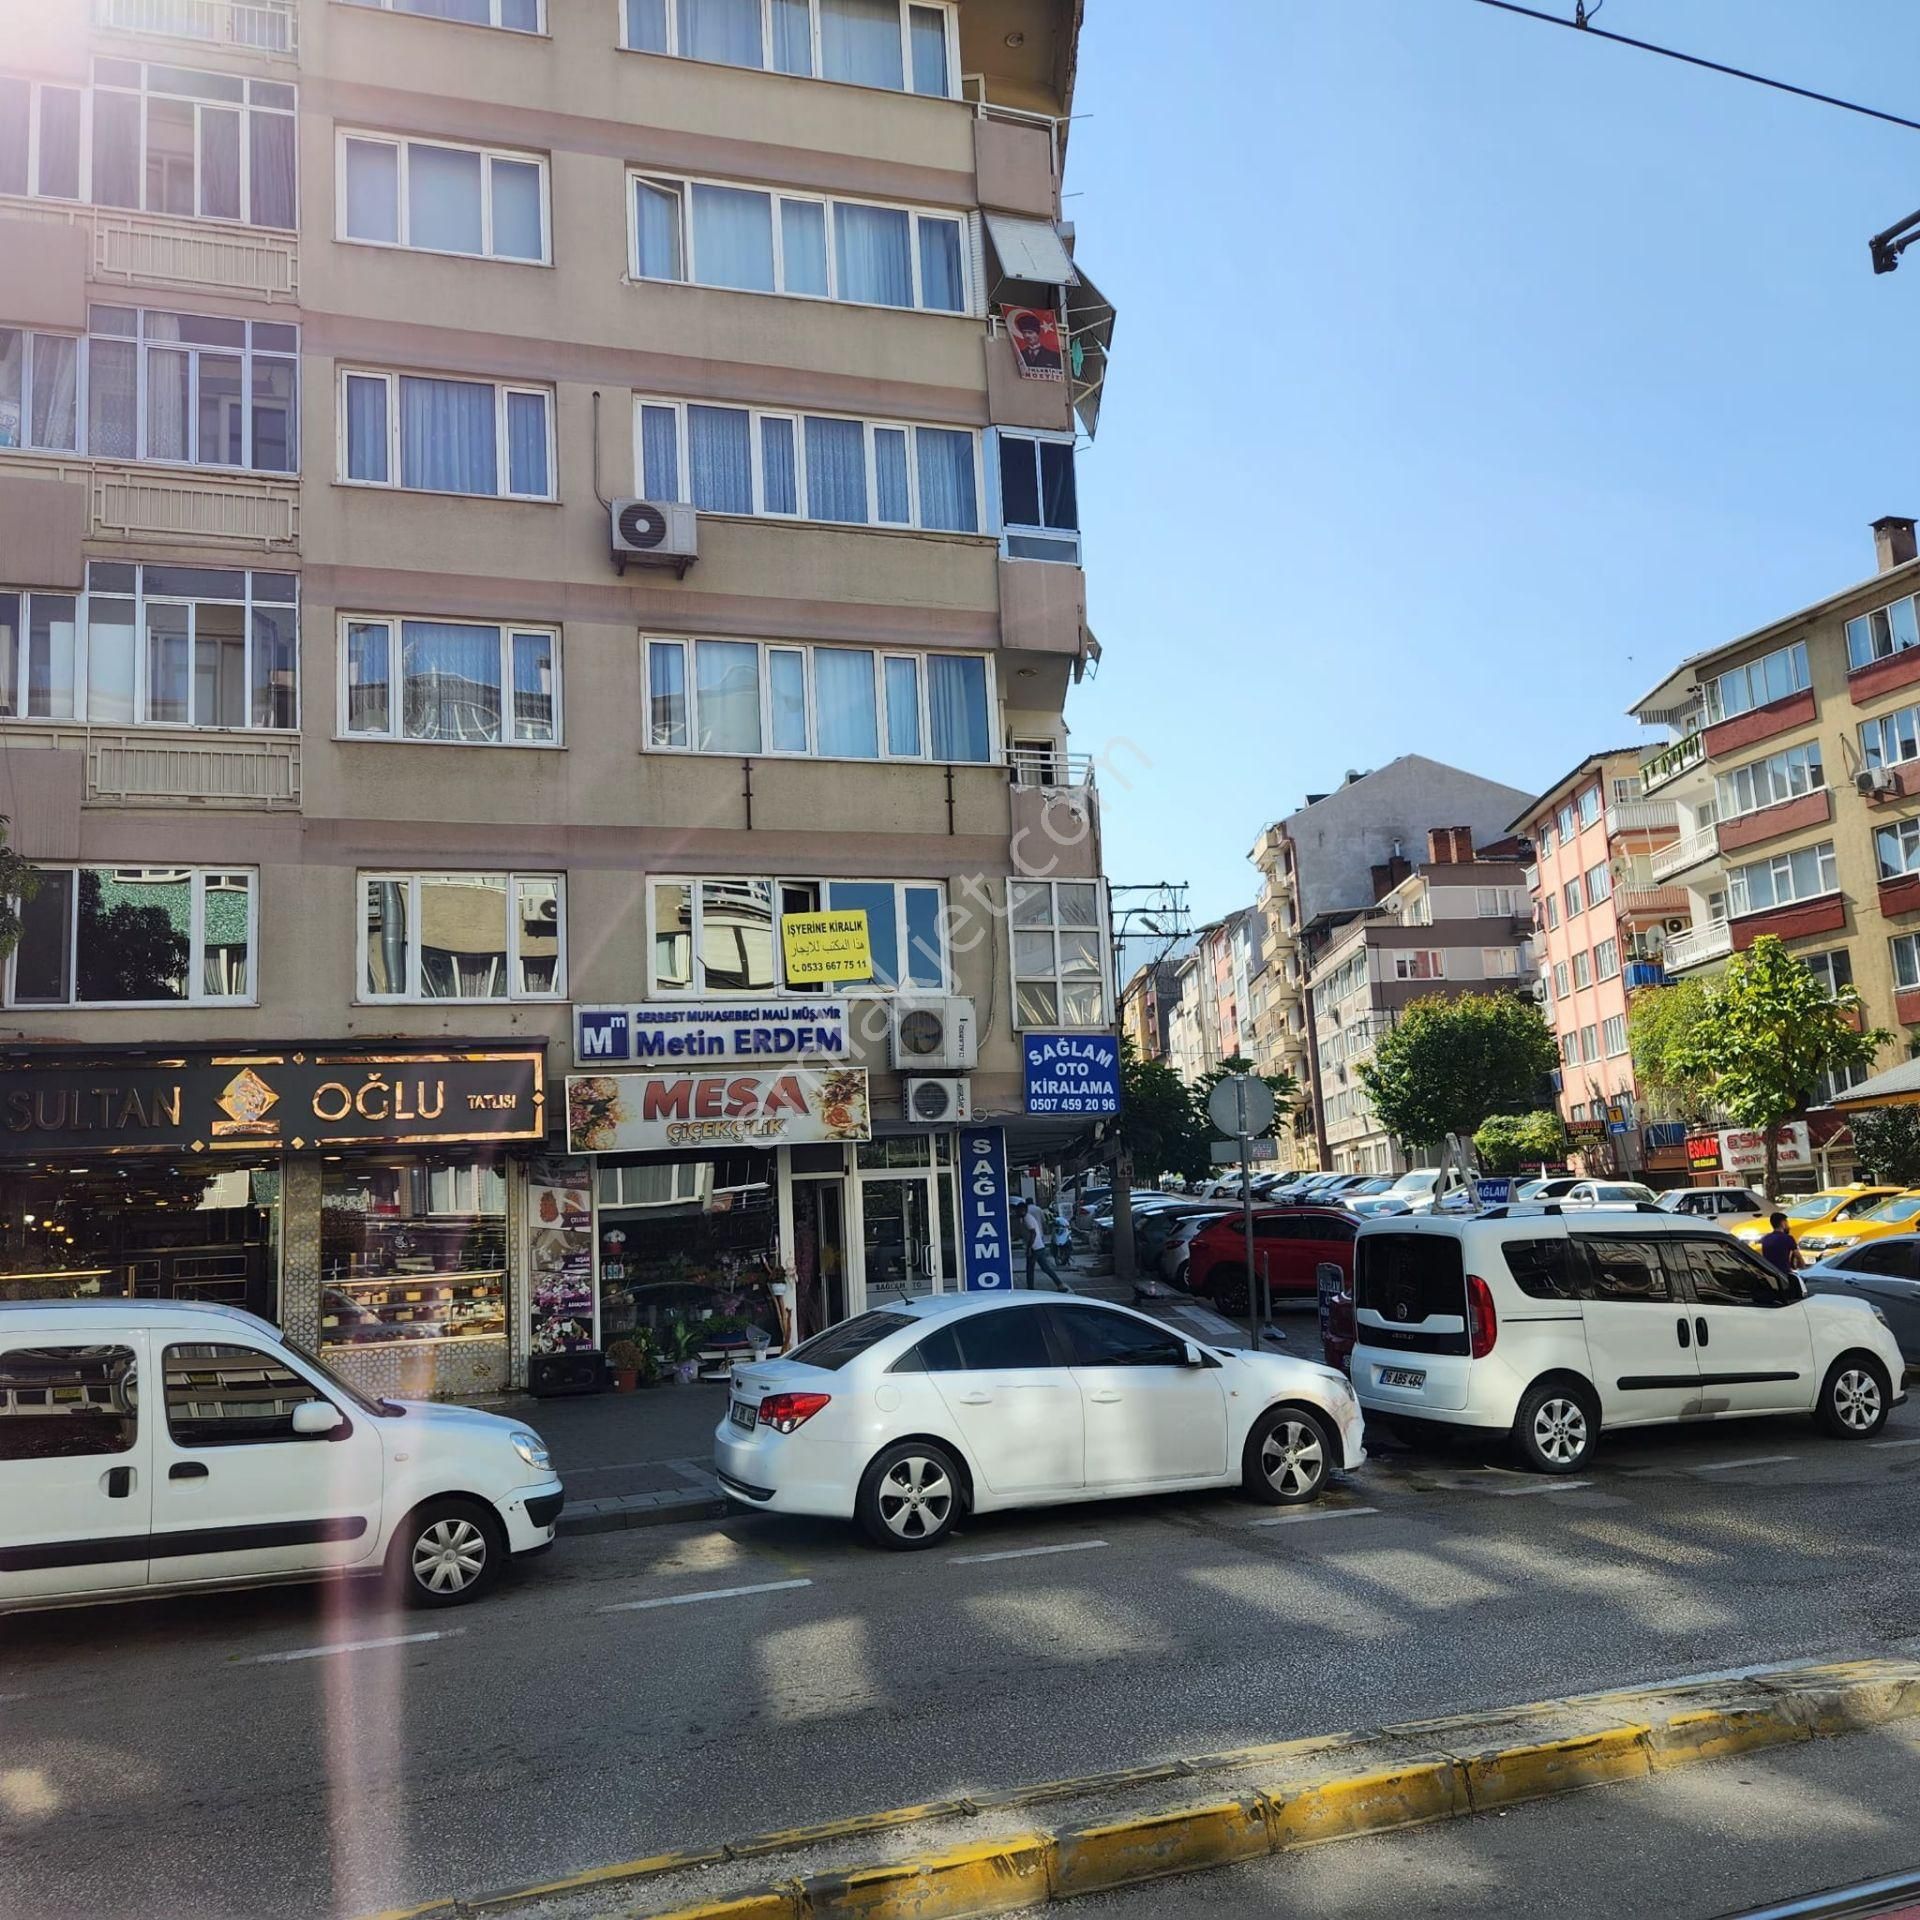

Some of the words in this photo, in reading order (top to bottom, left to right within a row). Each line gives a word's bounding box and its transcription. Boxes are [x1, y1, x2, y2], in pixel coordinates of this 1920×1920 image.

[787, 921, 827, 937] İŞYERİNE
[829, 919, 863, 932] KİRALIK
[822, 939, 850, 954] المكتب
[852, 938, 864, 950] هذا
[801, 963, 823, 972] 0533
[825, 961, 841, 971] 667
[843, 960, 854, 969] 75
[856, 960, 867, 968] 11
[637, 1012, 684, 1023] SERBEST
[687, 1007, 759, 1022] MUHASEBECİ
[762, 1007, 788, 1020] MALİ
[637, 1028, 724, 1057] Metin
[734, 1026, 842, 1055] ERDEM
[1029, 1037, 1114, 1068] SAĞLAM
[1055, 1062, 1089, 1076] OTO
[1030, 1077, 1114, 1094] KİRALAMA
[8, 1085, 182, 1132] SULTAN
[312, 1073, 444, 1121] OĞLU
[643, 1076, 809, 1120] MESA
[1030, 1098, 1058, 1111] 0507
[1061, 1098, 1082, 1111] 459
[1085, 1098, 1099, 1111] 20
[1101, 1098, 1116, 1111] 96
[666, 1117, 785, 1146] ÇİÇEKÇİLİK
[972, 1139, 1000, 1259] SAĞLAM
[1479, 1184, 1508, 1198] AĞLAM
